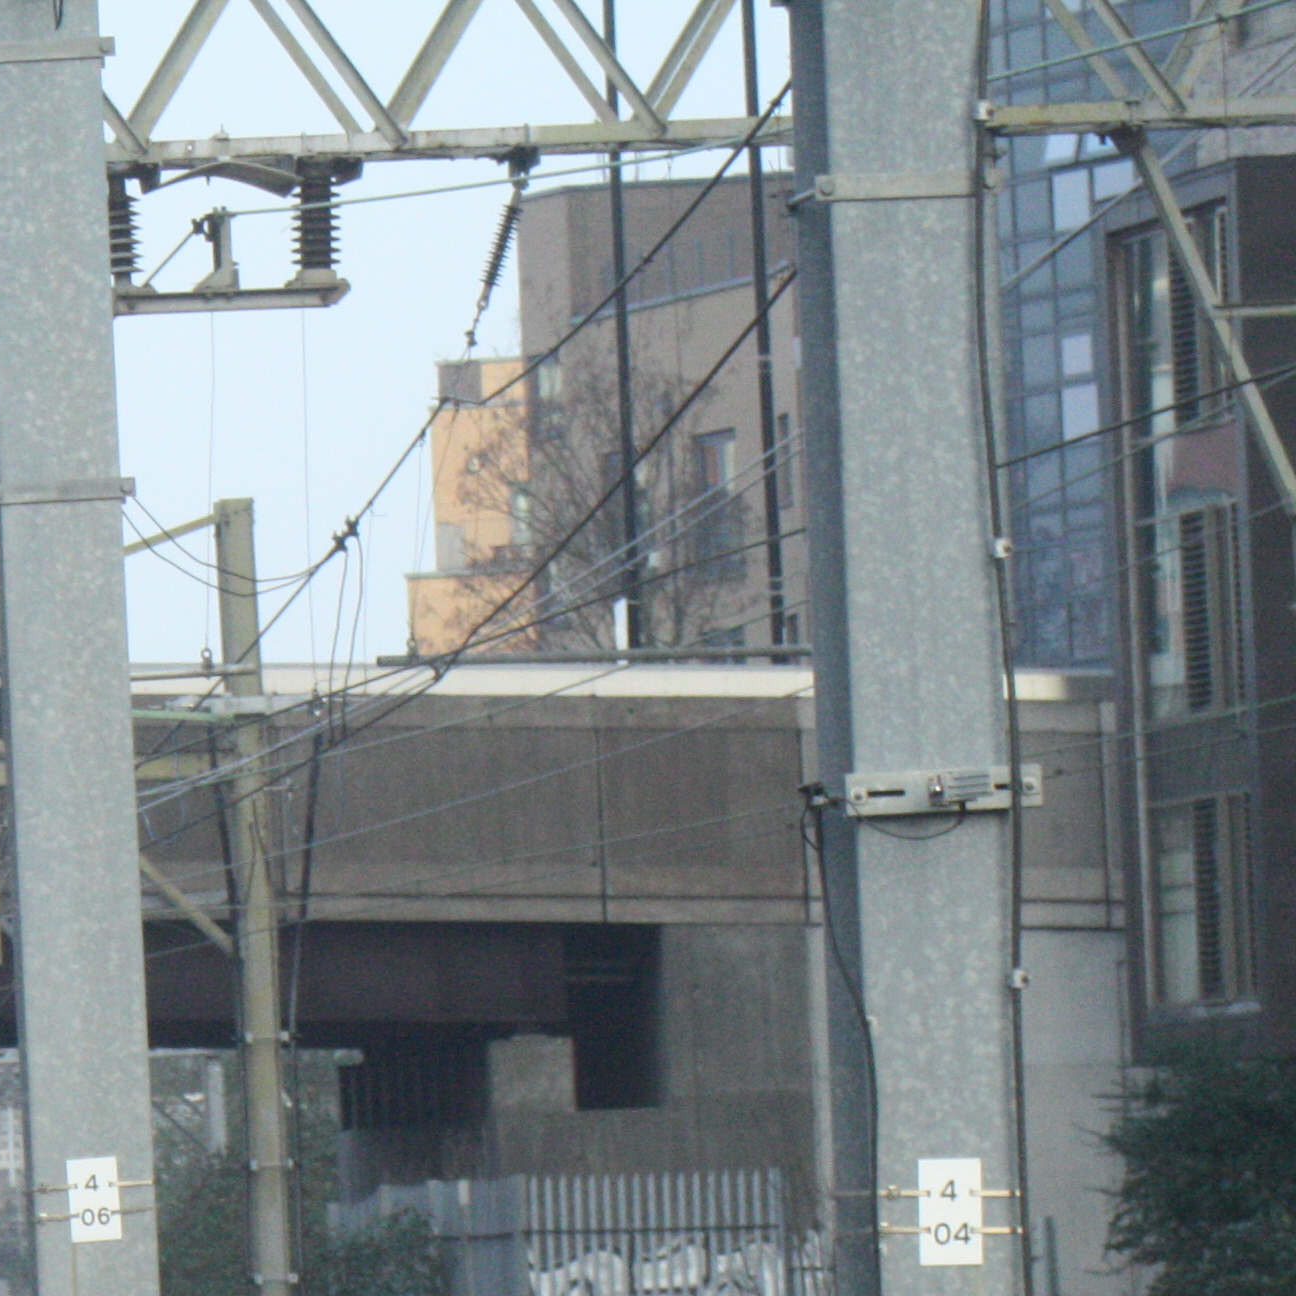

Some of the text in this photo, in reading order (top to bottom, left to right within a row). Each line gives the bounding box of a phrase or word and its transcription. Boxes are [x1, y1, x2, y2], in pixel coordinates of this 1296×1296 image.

[84, 1174, 99, 1192] 4
[939, 1179, 957, 1201] 4
[81, 1207, 111, 1226] 06
[934, 1222, 970, 1245] 04
